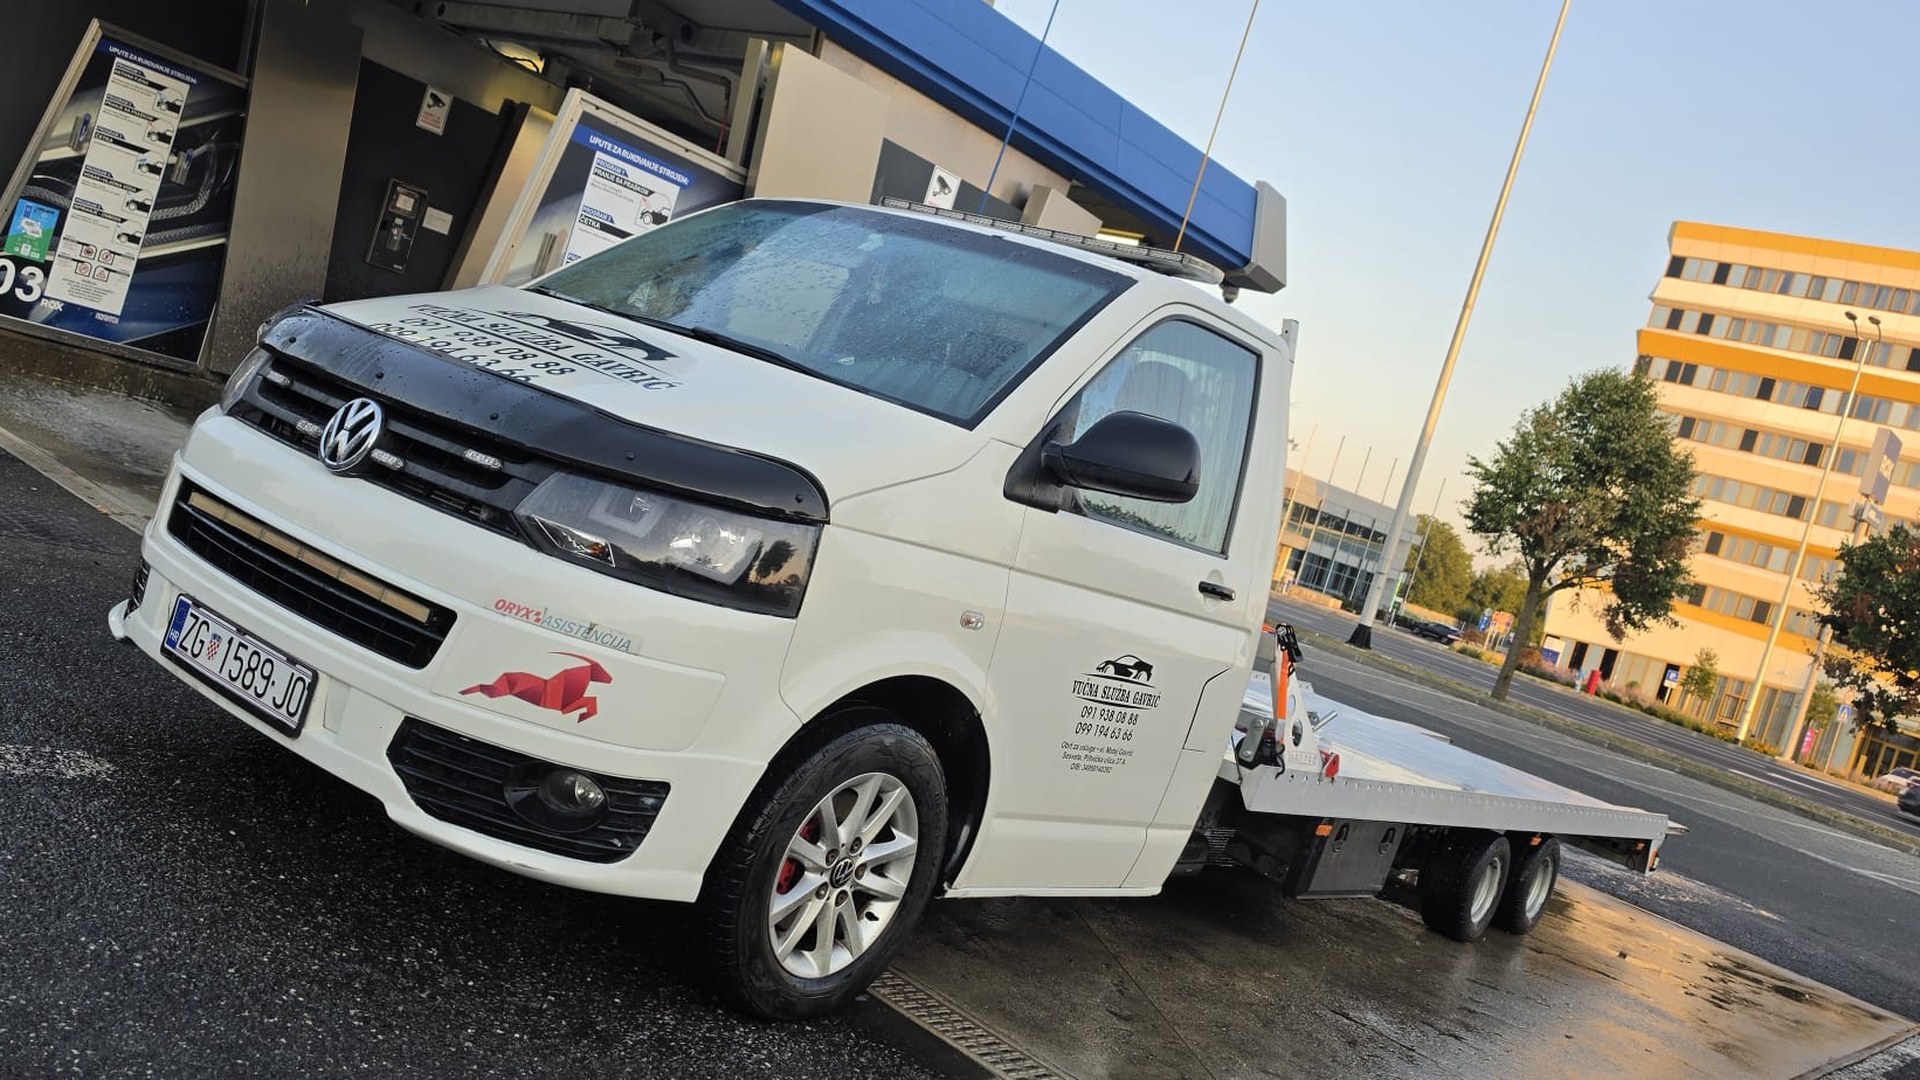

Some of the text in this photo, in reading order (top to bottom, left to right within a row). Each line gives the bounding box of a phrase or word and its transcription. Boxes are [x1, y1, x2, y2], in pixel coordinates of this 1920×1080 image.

[589, 134, 613, 151] UPUTE
[612, 143, 622, 154] ZA
[621, 147, 659, 172] RUKOVANJE
[580, 213, 601, 230] ČETKA
[400, 317, 576, 375] 091 938 08 88
[178, 612, 210, 659] ZG
[494, 598, 632, 653] ORYX ASISTENCIJA
[1075, 722, 1133, 741] 099 194 63 66
[1081, 705, 1139, 726] 091 938 08 88
